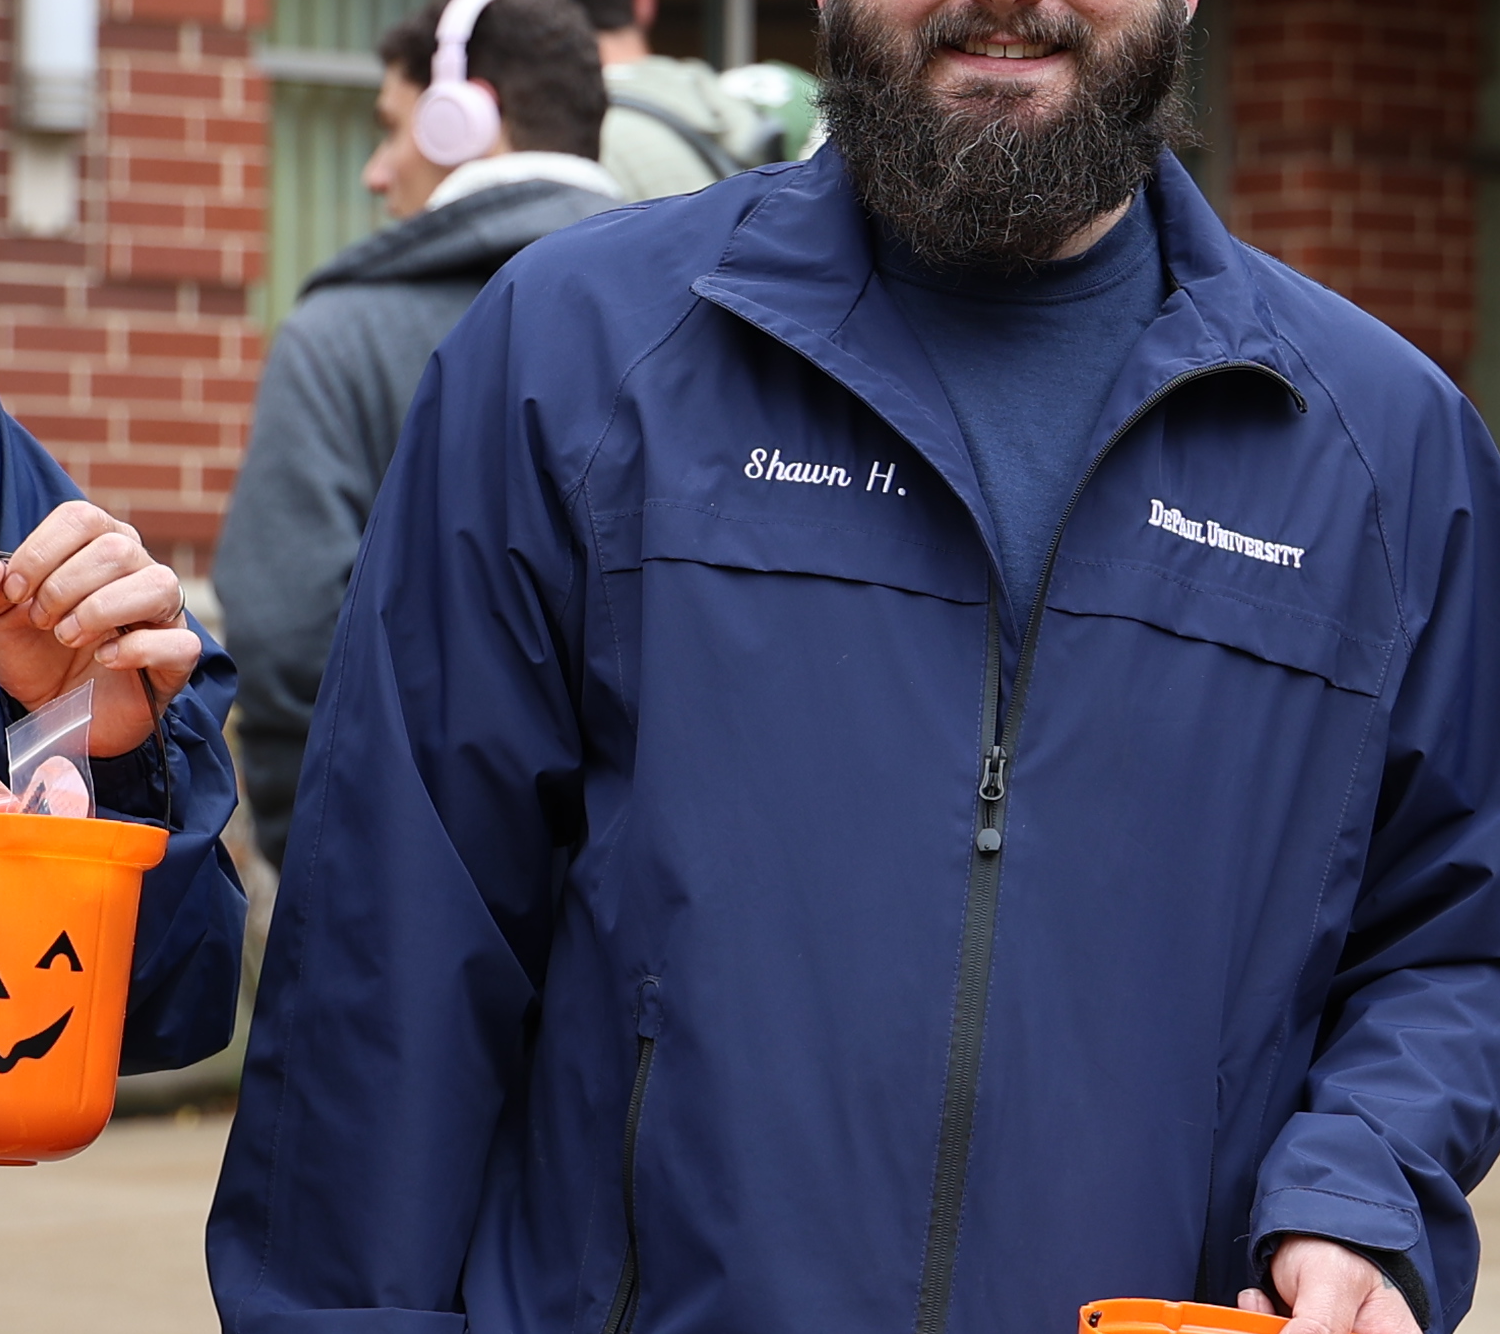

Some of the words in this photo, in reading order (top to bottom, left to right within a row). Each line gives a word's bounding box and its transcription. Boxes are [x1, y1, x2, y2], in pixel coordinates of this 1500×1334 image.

[743, 446, 852, 489] Shawn
[865, 459, 908, 497] H.
[1205, 519, 1306, 569] UNIVERSITY
